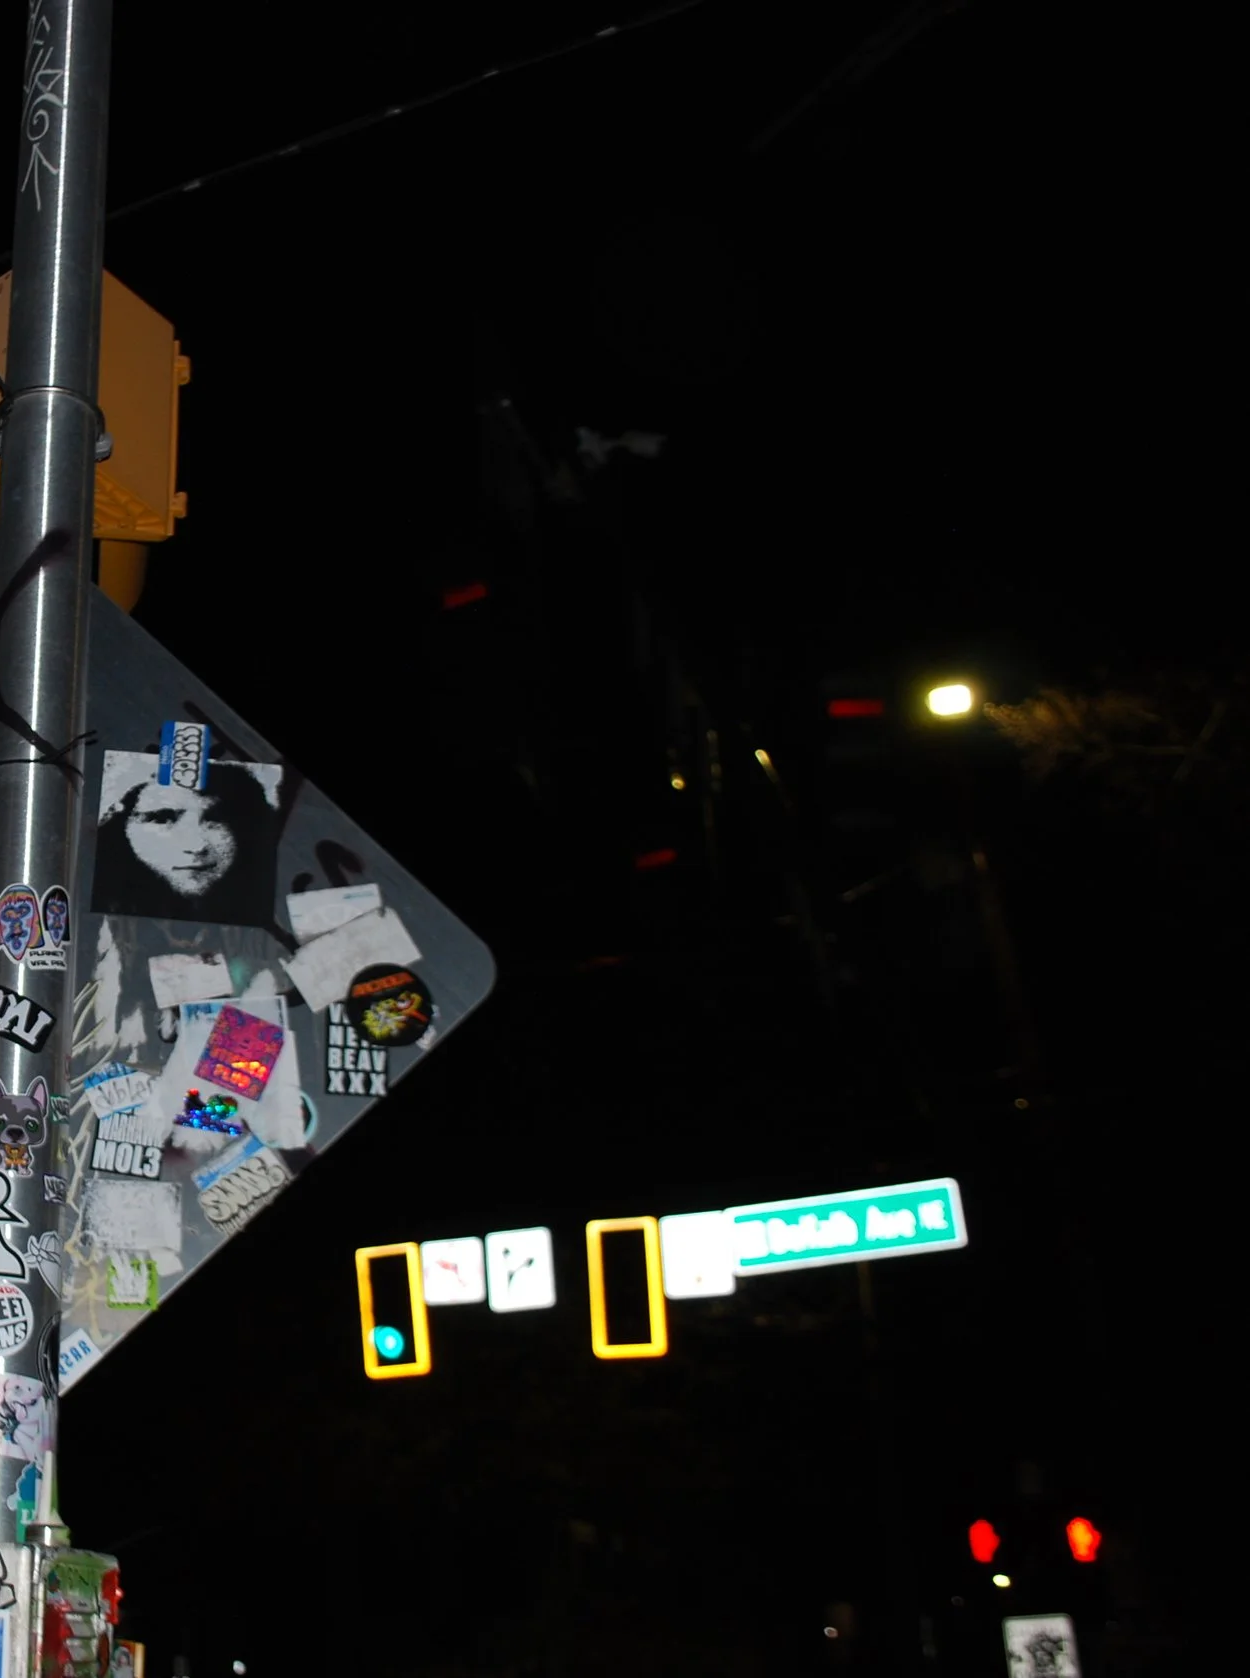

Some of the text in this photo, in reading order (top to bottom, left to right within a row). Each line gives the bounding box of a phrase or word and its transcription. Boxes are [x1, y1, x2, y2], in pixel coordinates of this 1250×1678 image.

[328, 1047, 387, 1072] BEAV
[328, 1070, 387, 1096] XXX
[92, 1139, 162, 1178] MOL3
